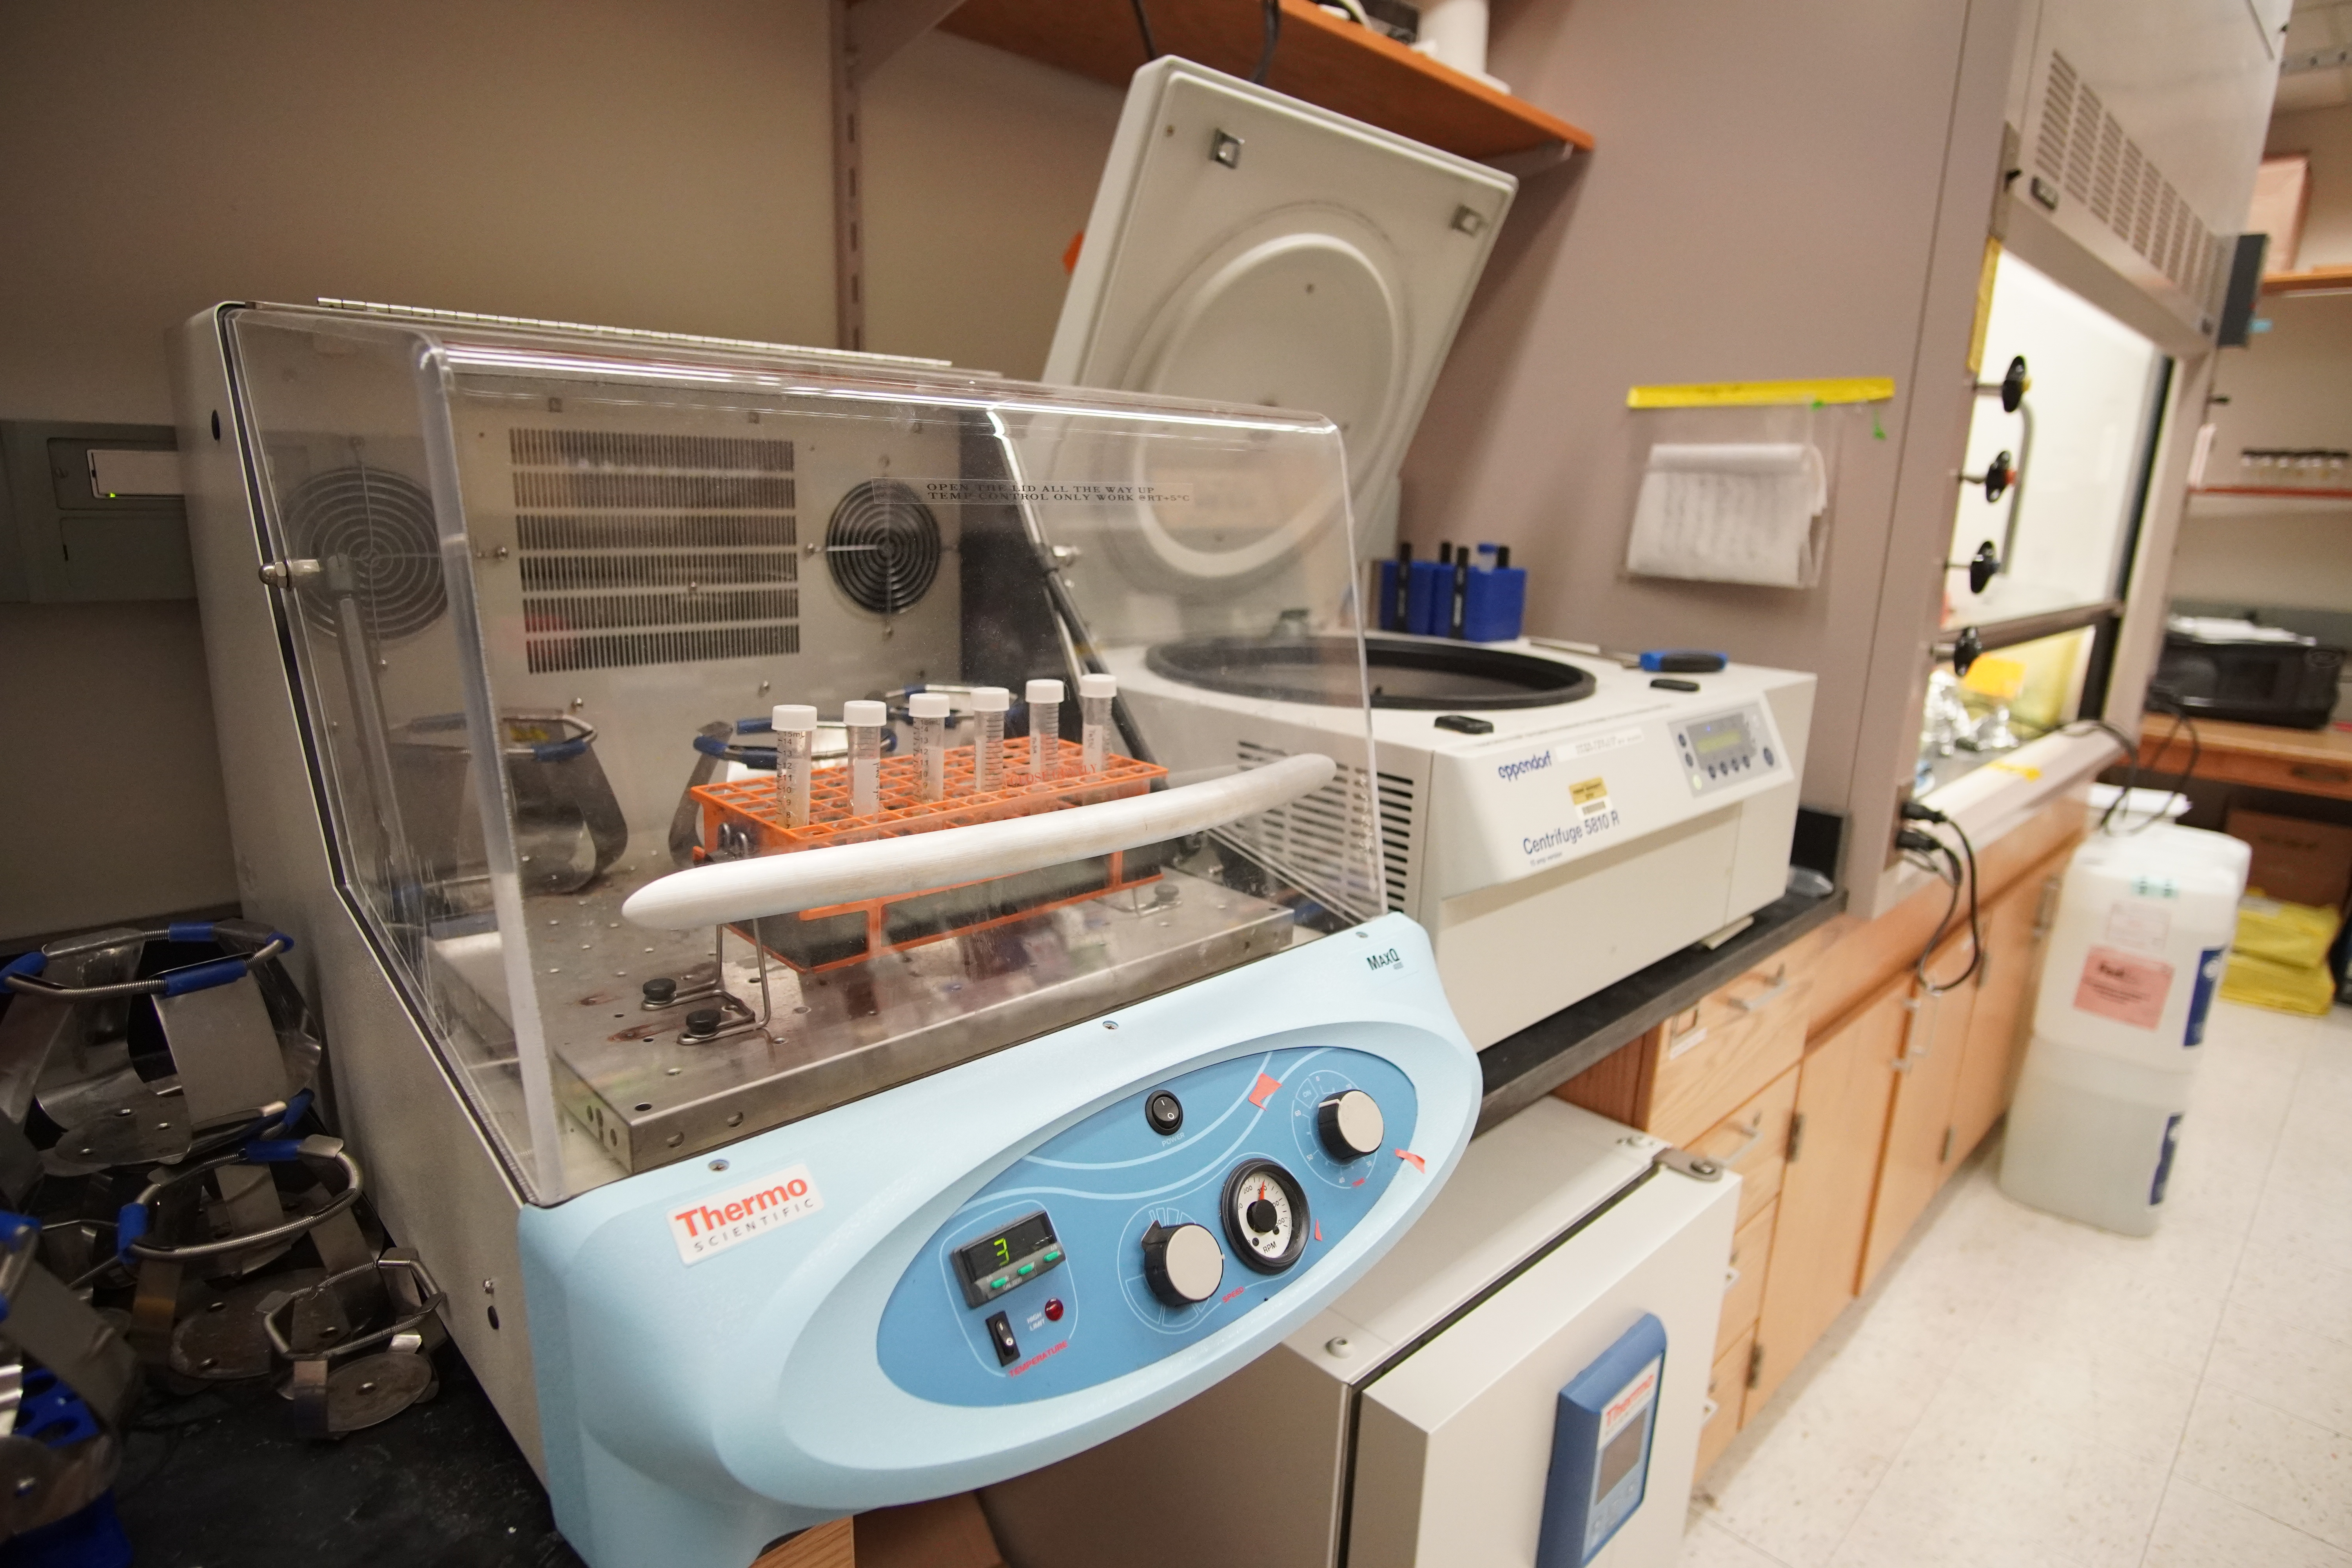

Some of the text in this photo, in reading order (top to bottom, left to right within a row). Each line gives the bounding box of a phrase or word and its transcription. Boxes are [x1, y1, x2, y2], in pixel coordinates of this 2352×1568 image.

[1010, 771, 1047, 785] CLOSE
[1498, 750, 1552, 782] eppendorf
[1523, 809, 1620, 855] Centrifuge 5810 R
[1161, 1132, 1185, 1147] POWER
[1243, 1185, 1253, 1194] 200
[675, 1178, 808, 1238] Thermo
[693, 1198, 814, 1252] SCIENTIFIC
[993, 1238, 1010, 1267] 3
[1263, 1241, 1277, 1254] RPM
[1222, 1286, 1245, 1303] SPEED
[1009, 1339, 1068, 1378] TEMPERATURE
